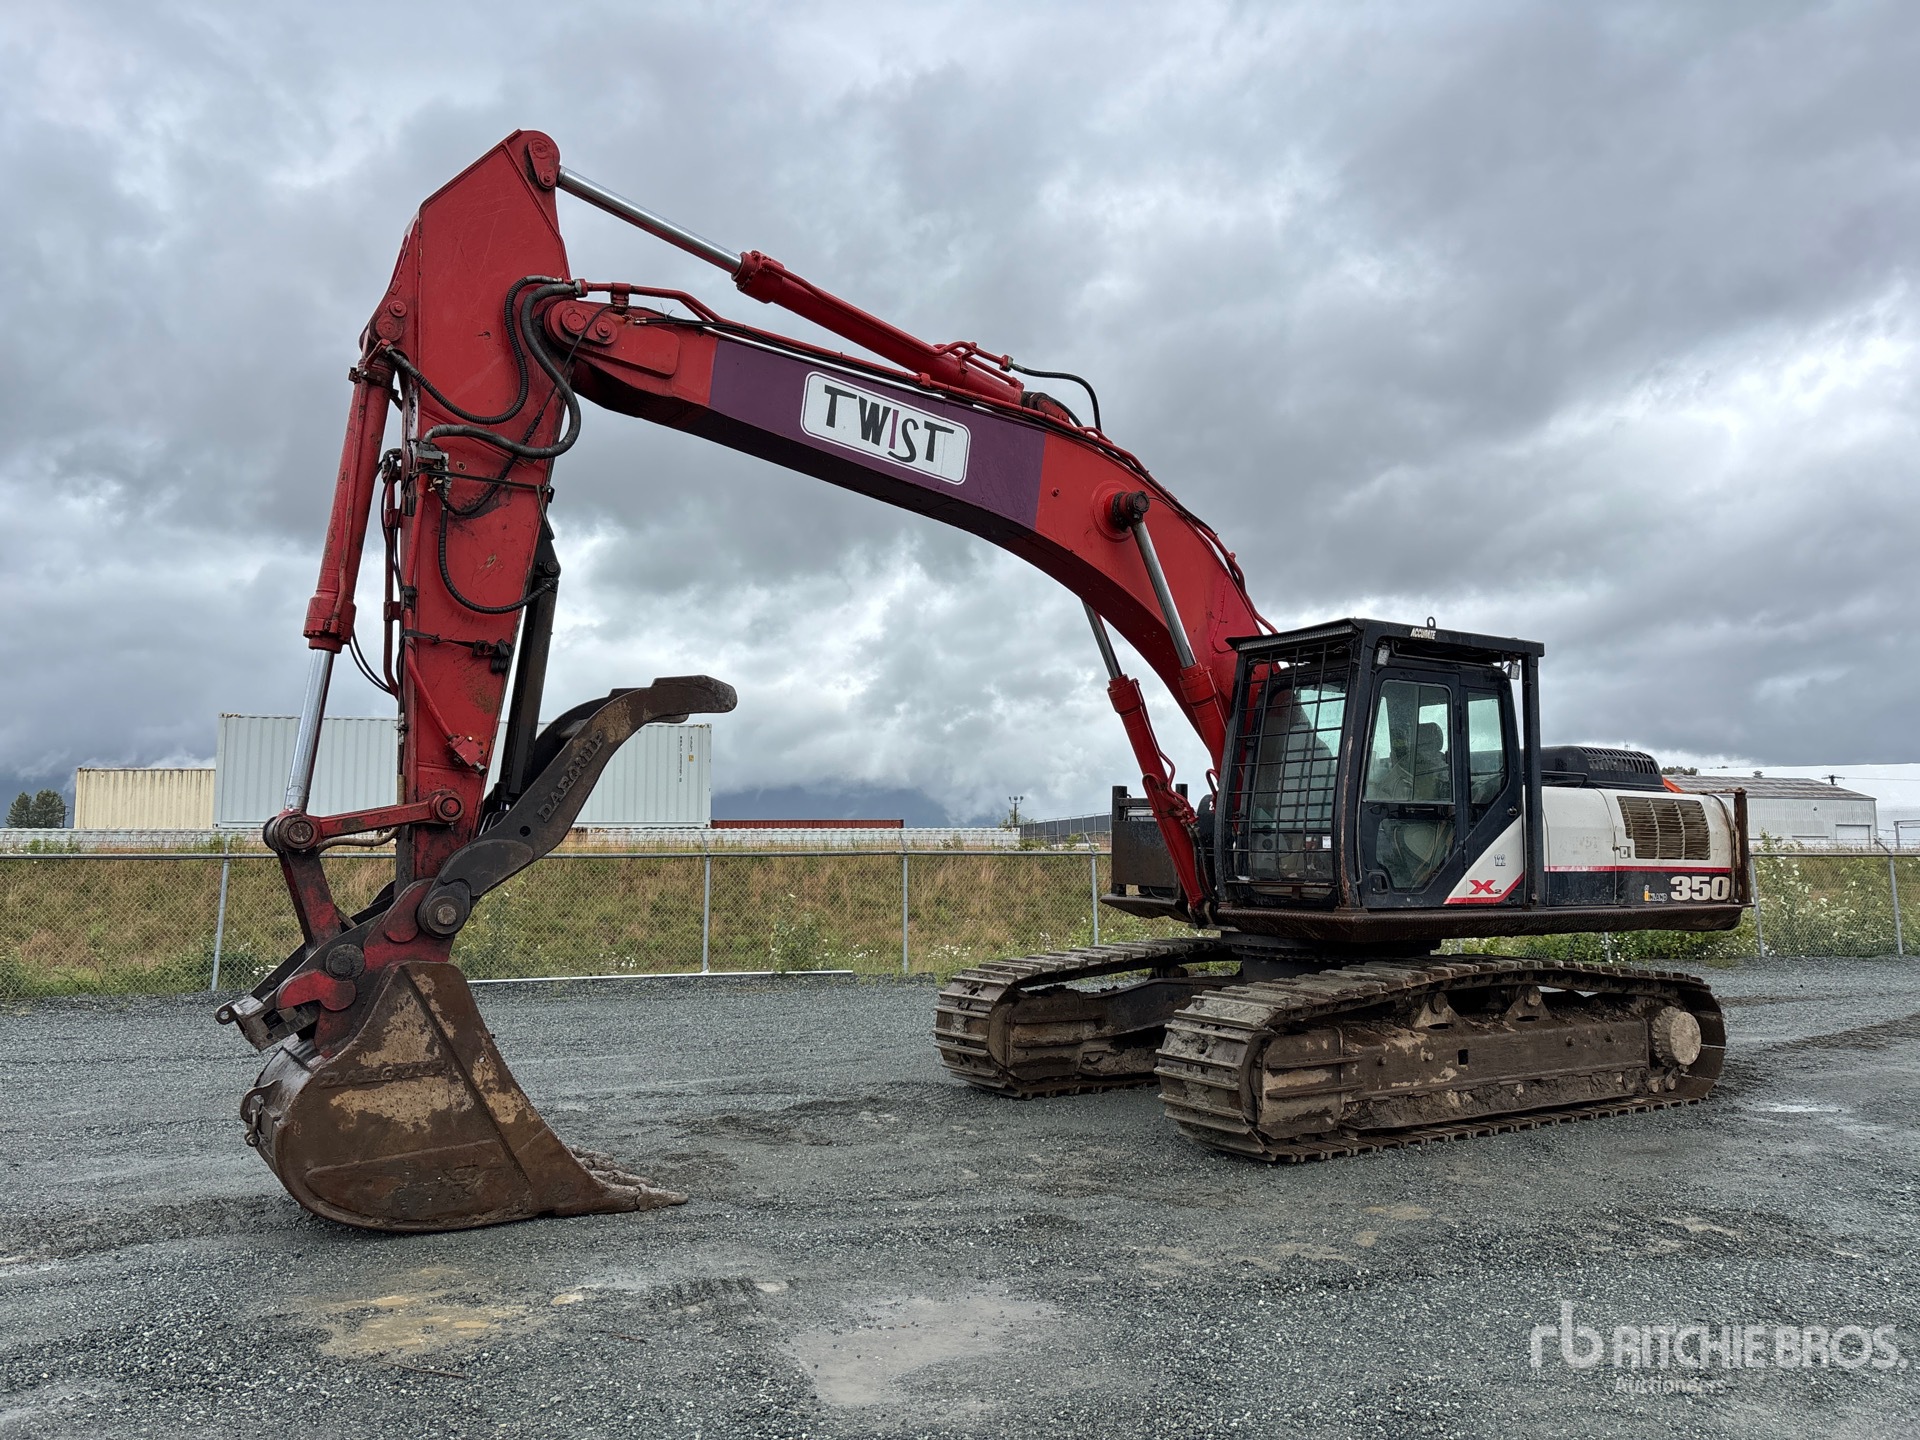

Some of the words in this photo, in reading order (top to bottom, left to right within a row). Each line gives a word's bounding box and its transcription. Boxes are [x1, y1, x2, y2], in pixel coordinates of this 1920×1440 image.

[824, 384, 955, 463] TWIST
[537, 730, 603, 823] DAEQUIP
[1670, 875, 1731, 901] 350
